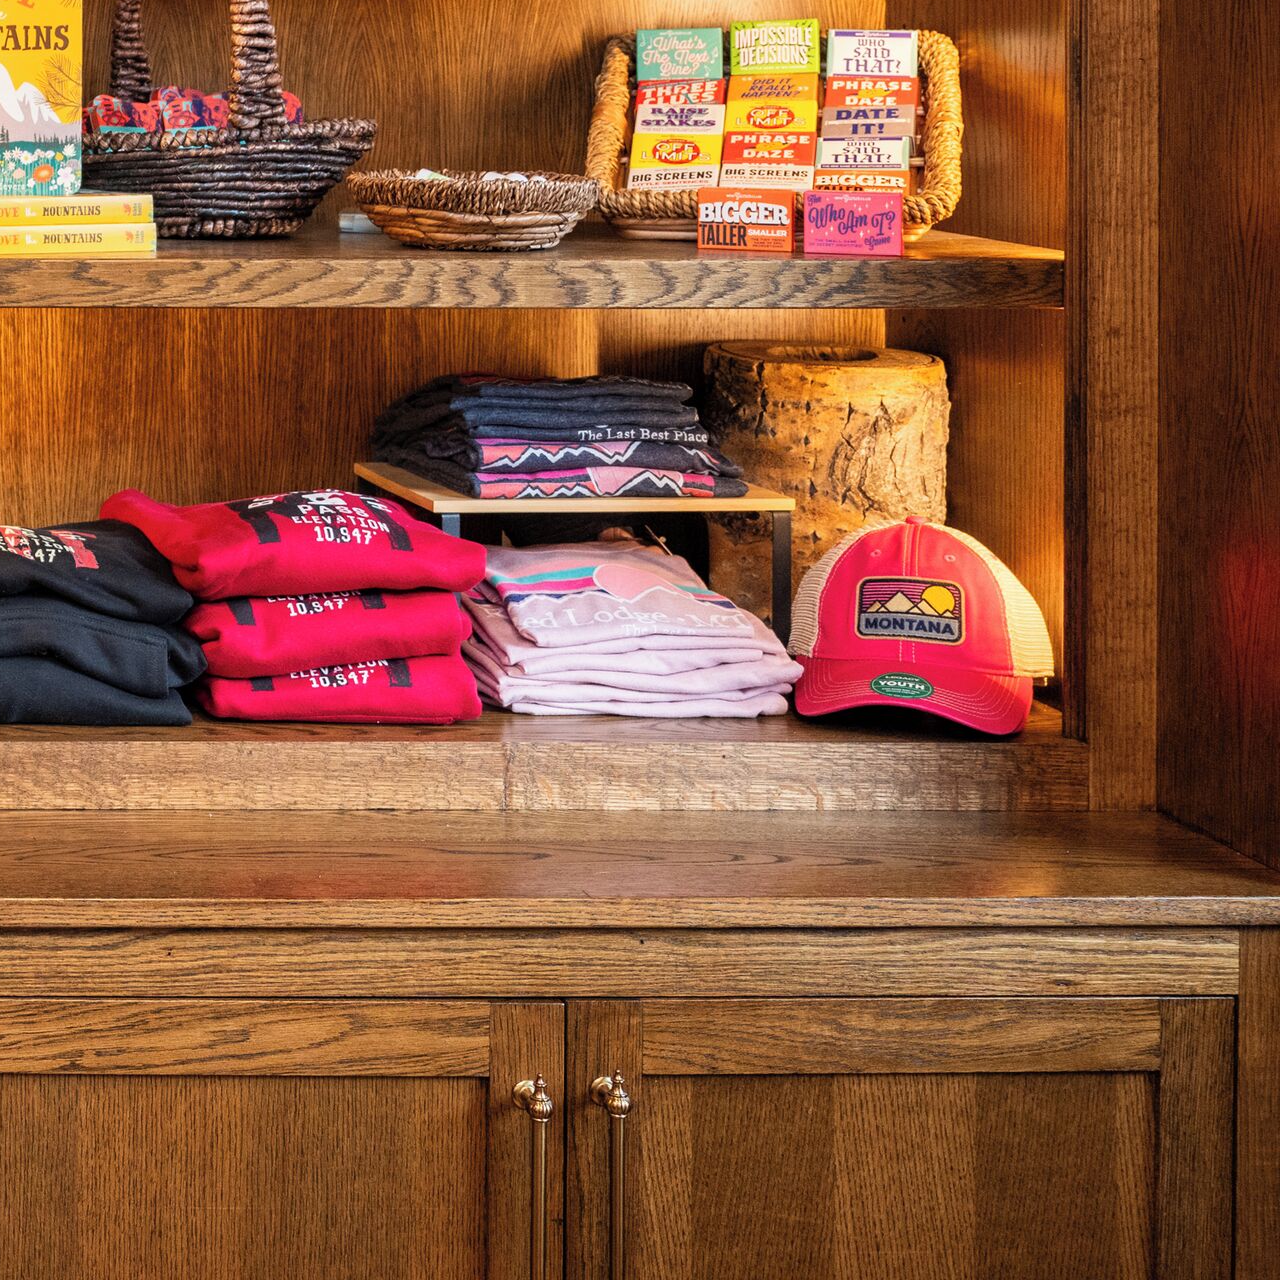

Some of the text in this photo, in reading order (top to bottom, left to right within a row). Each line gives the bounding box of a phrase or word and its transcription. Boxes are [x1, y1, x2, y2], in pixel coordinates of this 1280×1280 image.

[653, 35, 706, 51] What's
[735, 26, 813, 48] IMPOSSIBLE
[642, 50, 709, 65] The Next
[740, 46, 809, 67] DECISIONS
[854, 47, 890, 58] SAID
[660, 62, 700, 77] Line?
[843, 58, 901, 73] THAT?
[640, 81, 718, 99] THREE
[832, 81, 912, 90] PHRASE
[642, 91, 715, 104] CLUES
[845, 96, 896, 105] DAZE
[651, 107, 709, 115] RAISE
[751, 109, 790, 117] OFF
[836, 108, 899, 120] DATE
[640, 119, 716, 127] STAKES
[852, 123, 884, 134] IT!
[730, 135, 810, 144] PHRASE
[656, 142, 695, 151] OFF
[642, 151, 711, 161] LIMITS
[743, 149, 794, 158] DAZE
[832, 154, 891, 163] THAT?
[632, 171, 713, 182] BIG SCREENS
[749, 169, 808, 177] SCREENS
[815, 174, 906, 188] BIGGER
[42, 205, 101, 217] MOUNTAINS
[698, 200, 790, 225] BIGGER
[808, 204, 868, 235] Who Am
[43, 233, 102, 245] MOUNTAINS
[699, 224, 747, 247] TALLER
[748, 229, 787, 237] SMALLER
[578, 428, 708, 442] The Last Best Place
[297, 504, 370, 518] PASS
[291, 515, 390, 533] ELEVATION
[564, 606, 665, 627] Lodge
[864, 618, 955, 635] MONTANA
[879, 680, 925, 690] YOUTH
